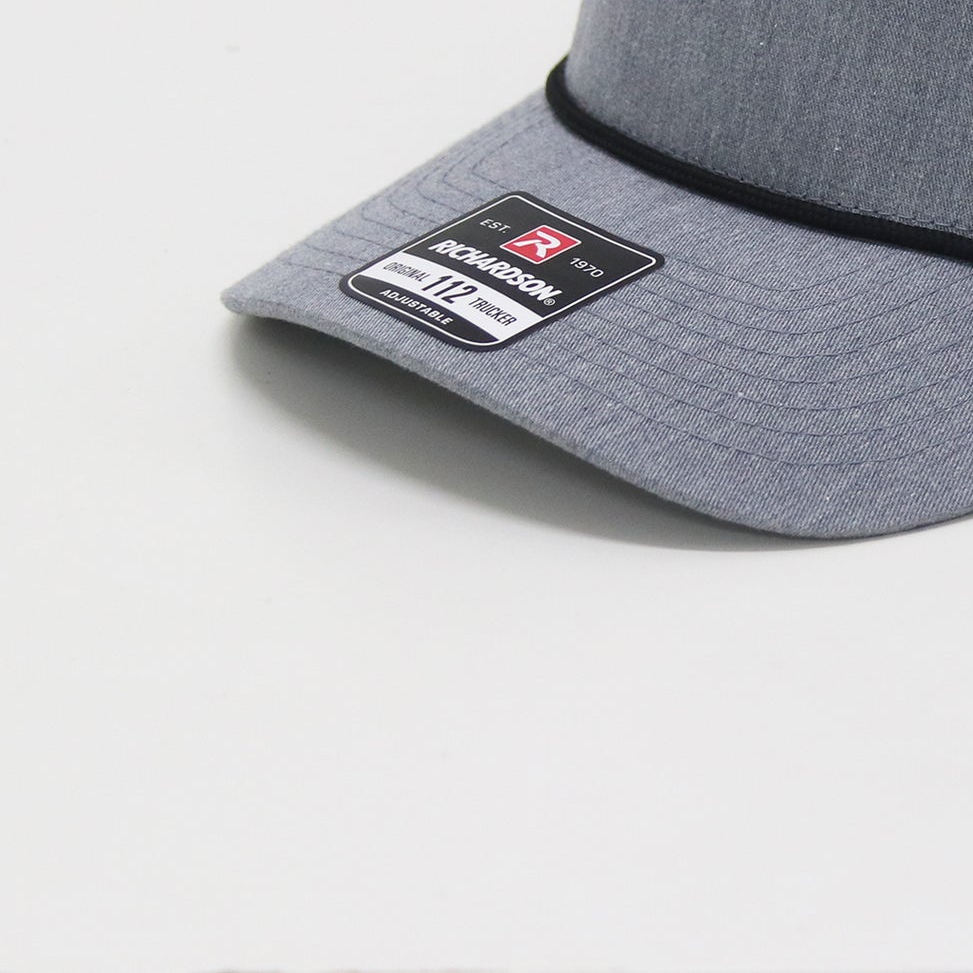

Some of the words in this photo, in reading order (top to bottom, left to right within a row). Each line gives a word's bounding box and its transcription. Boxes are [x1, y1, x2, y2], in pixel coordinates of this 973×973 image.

[480, 218, 511, 233] EST.
[570, 257, 604, 278] 1970
[379, 289, 455, 325] ADJUSTABLE
[383, 262, 432, 283] ORIGINAL
[422, 274, 478, 304] 112
[468, 297, 517, 327] TRUCKER
